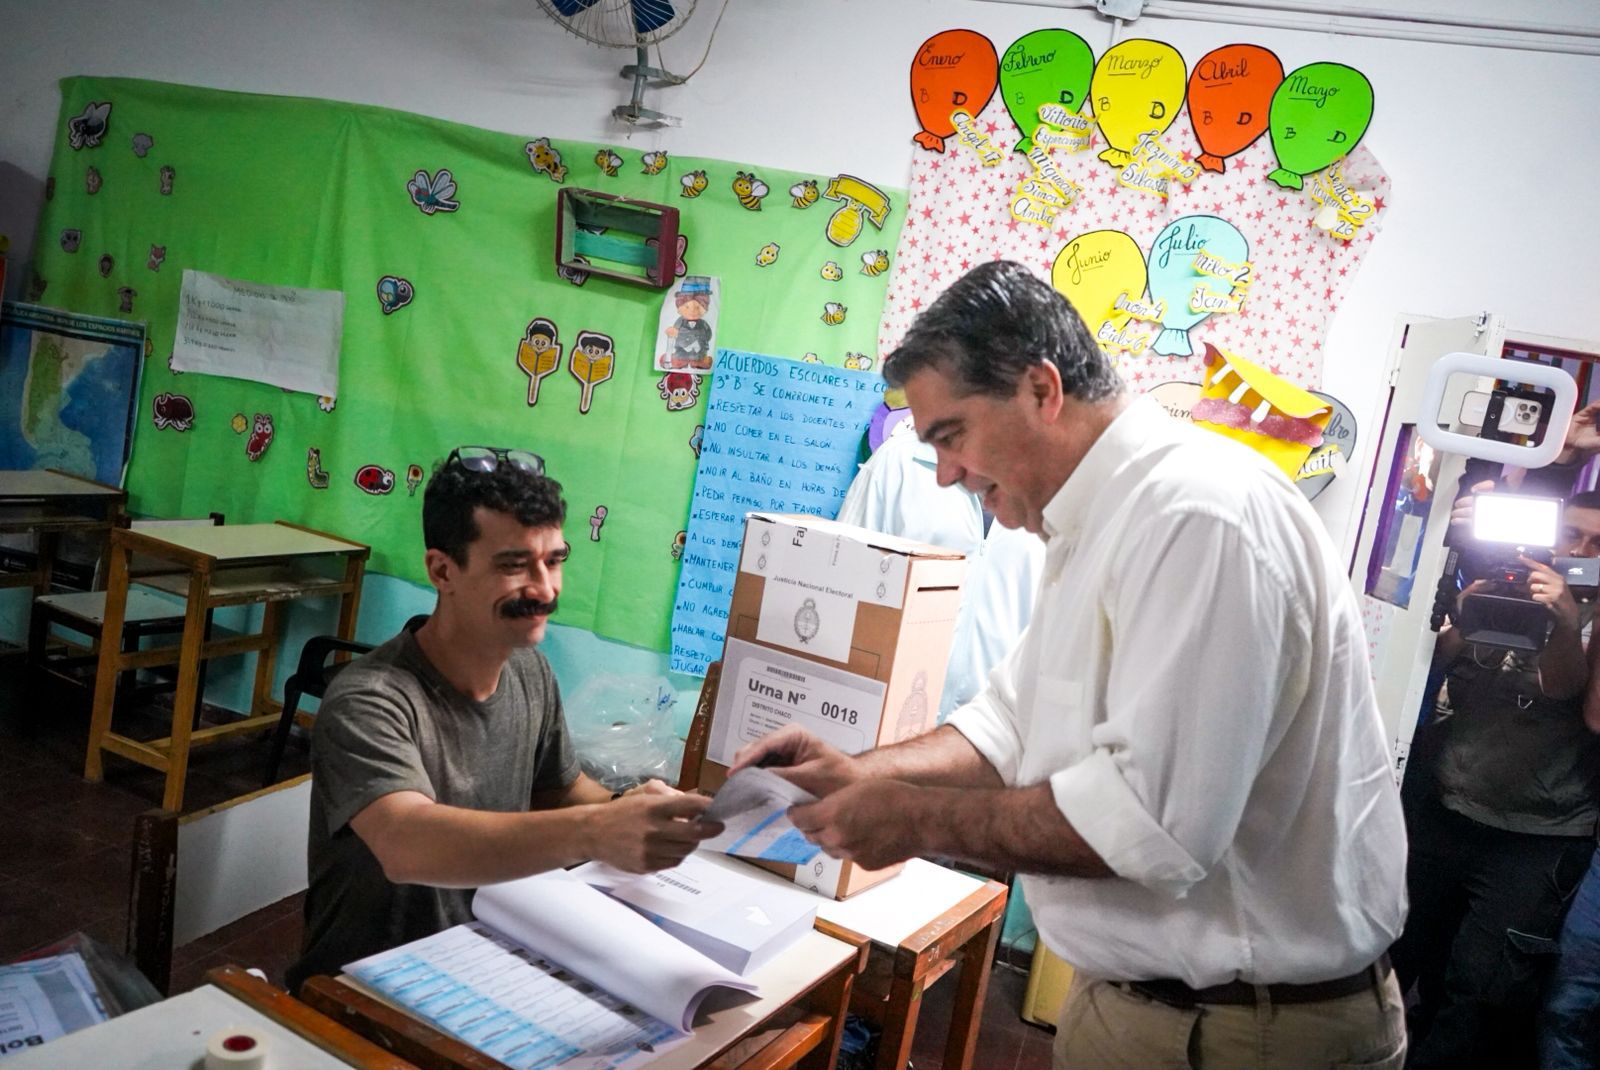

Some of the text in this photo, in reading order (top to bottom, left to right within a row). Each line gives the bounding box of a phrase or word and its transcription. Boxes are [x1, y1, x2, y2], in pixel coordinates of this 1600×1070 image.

[919, 43, 965, 66] Enero
[1003, 45, 1056, 72] Febrero
[1107, 54, 1163, 79] Marzo
[1198, 58, 1250, 81] Abril
[952, 91, 967, 105] D
[1059, 90, 1074, 104] D
[1289, 75, 1340, 107] Mayo
[1099, 97, 1165, 119] B D
[1203, 111, 1252, 125] B D
[1284, 127, 1347, 143] B D
[1348, 204, 1371, 220] 2
[1159, 224, 1209, 268] Julio
[1067, 243, 1112, 285] Junio
[1234, 266, 1251, 283] 2
[717, 351, 778, 376] ACUERDOS
[790, 366, 849, 388] ESCOLARES
[856, 380, 866, 391] DE
[753, 382, 766, 396] SE
[716, 399, 762, 416] RESPETAR
[766, 409, 773, 418] A
[780, 411, 794, 421] LOS
[803, 413, 845, 429] DOCENTES
[713, 422, 727, 432] NO
[735, 424, 763, 438] COMER
[768, 432, 780, 441] EN
[785, 435, 796, 445] EL
[709, 442, 722, 454] NO
[728, 446, 770, 462] INSULTAR
[778, 456, 784, 464] A
[791, 459, 807, 469] LOS
[705, 466, 718, 476] NO
[731, 470, 742, 480] AL
[750, 472, 773, 486] BAÑO
[779, 480, 791, 489] EN
[699, 509, 735, 524] ESPERAR
[792, 503, 822, 514] FAVOR
[691, 532, 697, 541] A
[702, 536, 716, 546] LOS
[689, 554, 735, 572] MANTENER
[688, 578, 723, 593] CUMPLIR
[773, 575, 853, 599] Justicia Nacional Electoral
[682, 601, 696, 612] NO
[677, 623, 705, 637] HABLAR
[674, 645, 712, 662] RESPETO
[674, 659, 704, 674] JUGAR
[748, 678, 783, 700] Urna
[821, 701, 858, 725] 0018
[752, 701, 792, 719] DISTRITO CHACO
